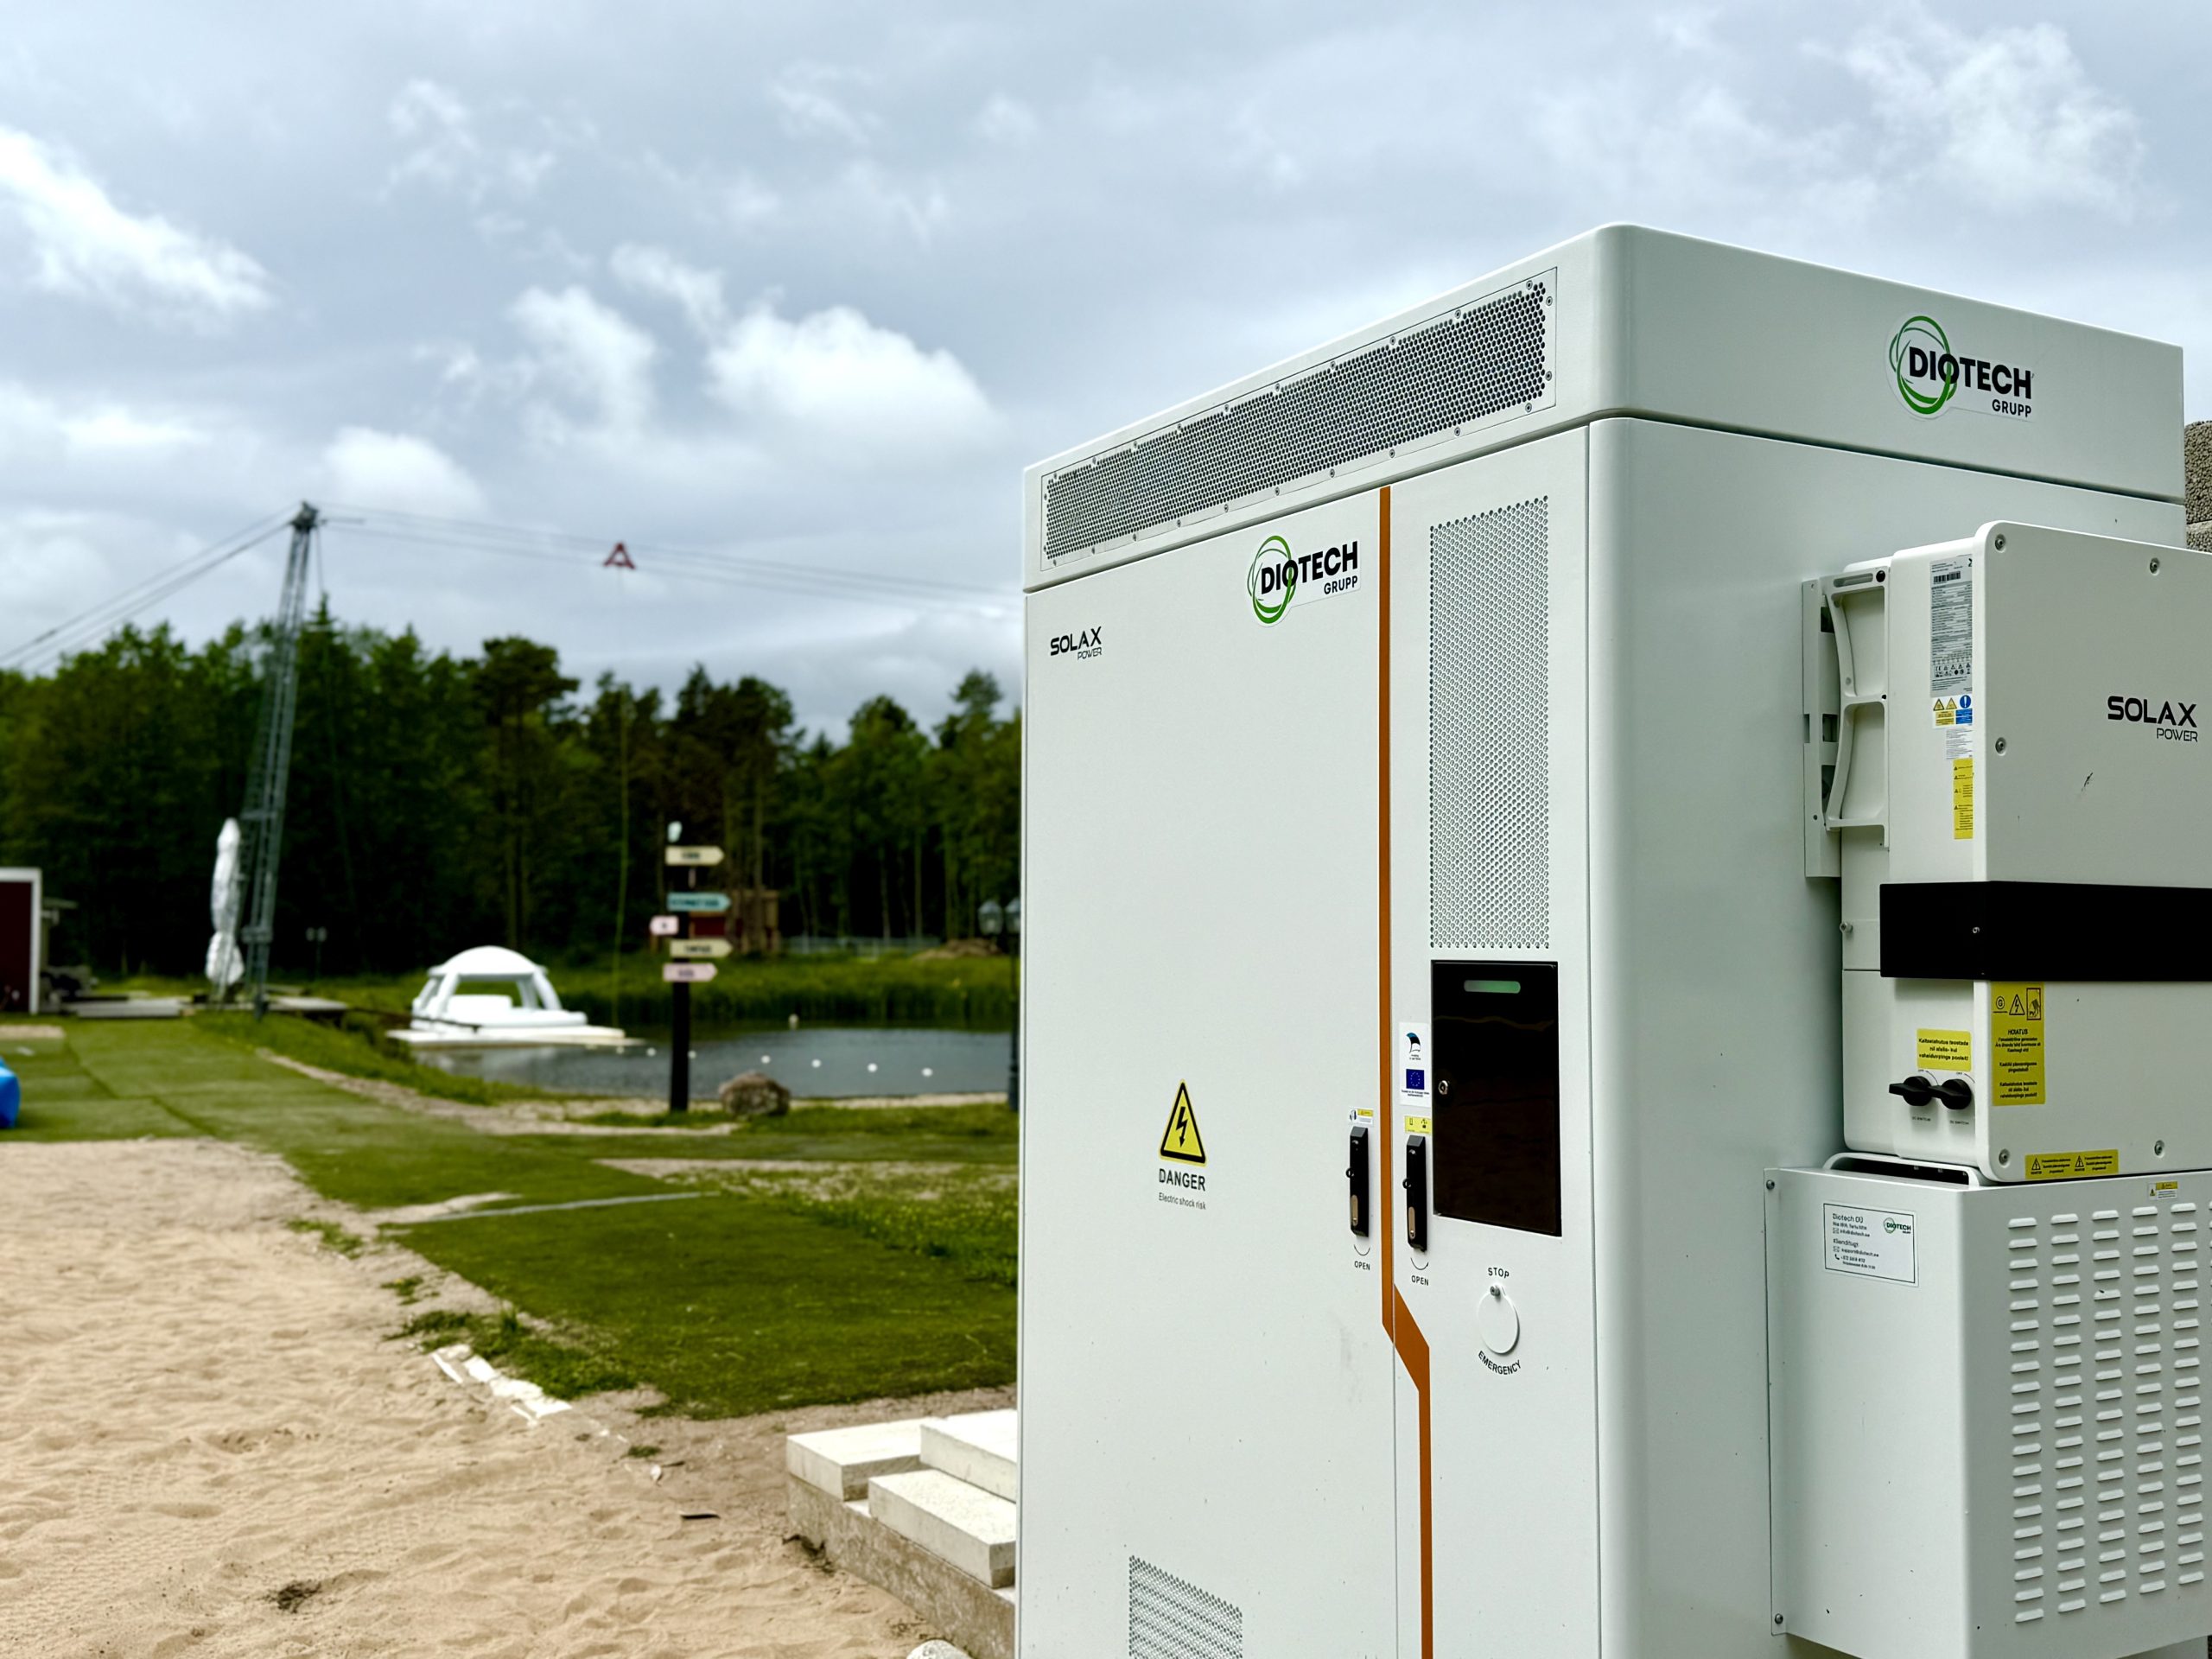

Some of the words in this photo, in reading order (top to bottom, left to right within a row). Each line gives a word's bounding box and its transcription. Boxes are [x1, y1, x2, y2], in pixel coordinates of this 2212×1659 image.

[1909, 346, 2032, 399] DIOTECH
[1992, 398, 2032, 418] GRUPP
[1261, 540, 1358, 594] DIOTECH
[1323, 576, 1358, 595] GRUPP
[1050, 626, 1103, 657] SOLAX
[1077, 646, 1103, 661] POWER
[2107, 696, 2197, 728] SOLAX
[2156, 728, 2198, 743] POWER
[1159, 1168, 1206, 1192] DANGER
[1159, 1192, 1179, 1205] Electric
[1179, 1196, 1196, 1208] shock
[1196, 1199, 1206, 1211] risk
[1832, 1213, 1854, 1223] Diotech
[1886, 1222, 1911, 1230] DIOTECH
[1354, 1260, 1371, 1271] OPEN
[1488, 1266, 1510, 1280] STOP
[1411, 1274, 1430, 1287] OPEN
[1478, 1351, 1522, 1376] EMERGENCY
